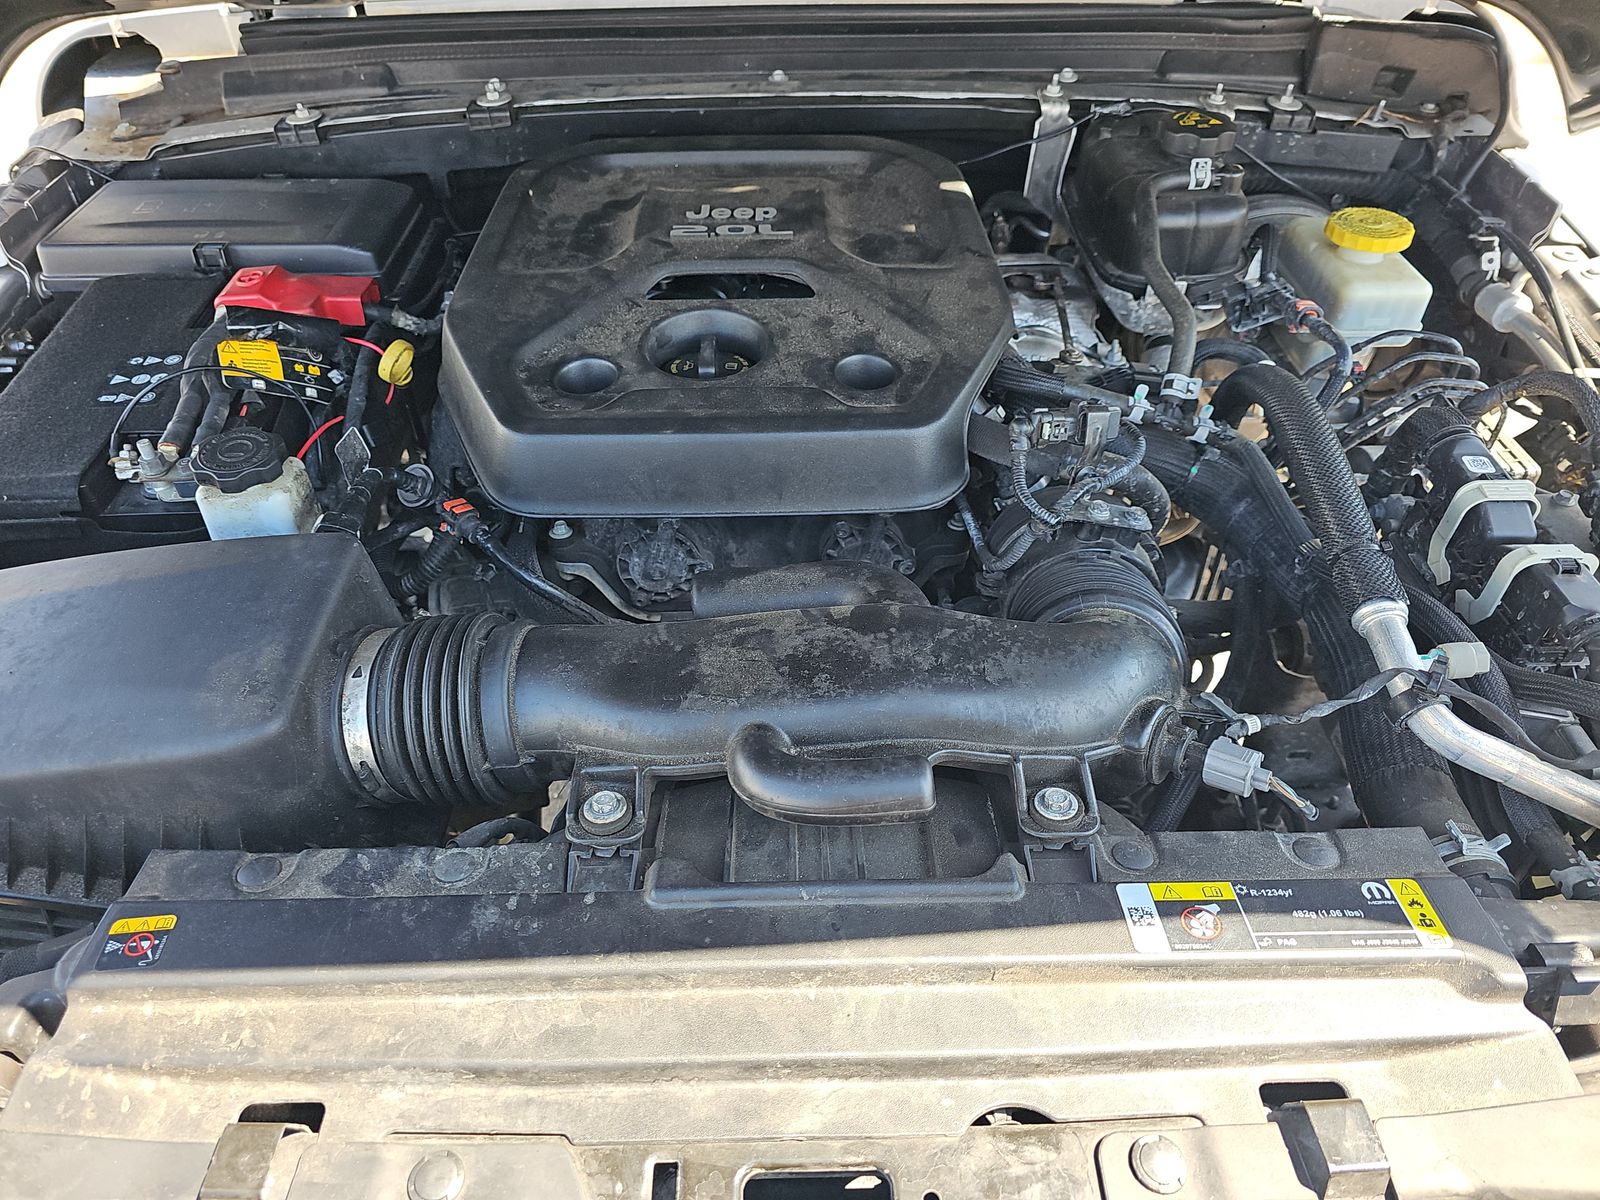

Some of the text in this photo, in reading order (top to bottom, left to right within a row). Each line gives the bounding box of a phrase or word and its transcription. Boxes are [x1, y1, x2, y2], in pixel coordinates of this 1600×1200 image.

[686, 204, 777, 221] Jeep
[670, 224, 793, 238] 2.0L
[1250, 888, 1293, 898] R-1234yf
[1292, 909, 1365, 919] 482g (1.06 lbs)
